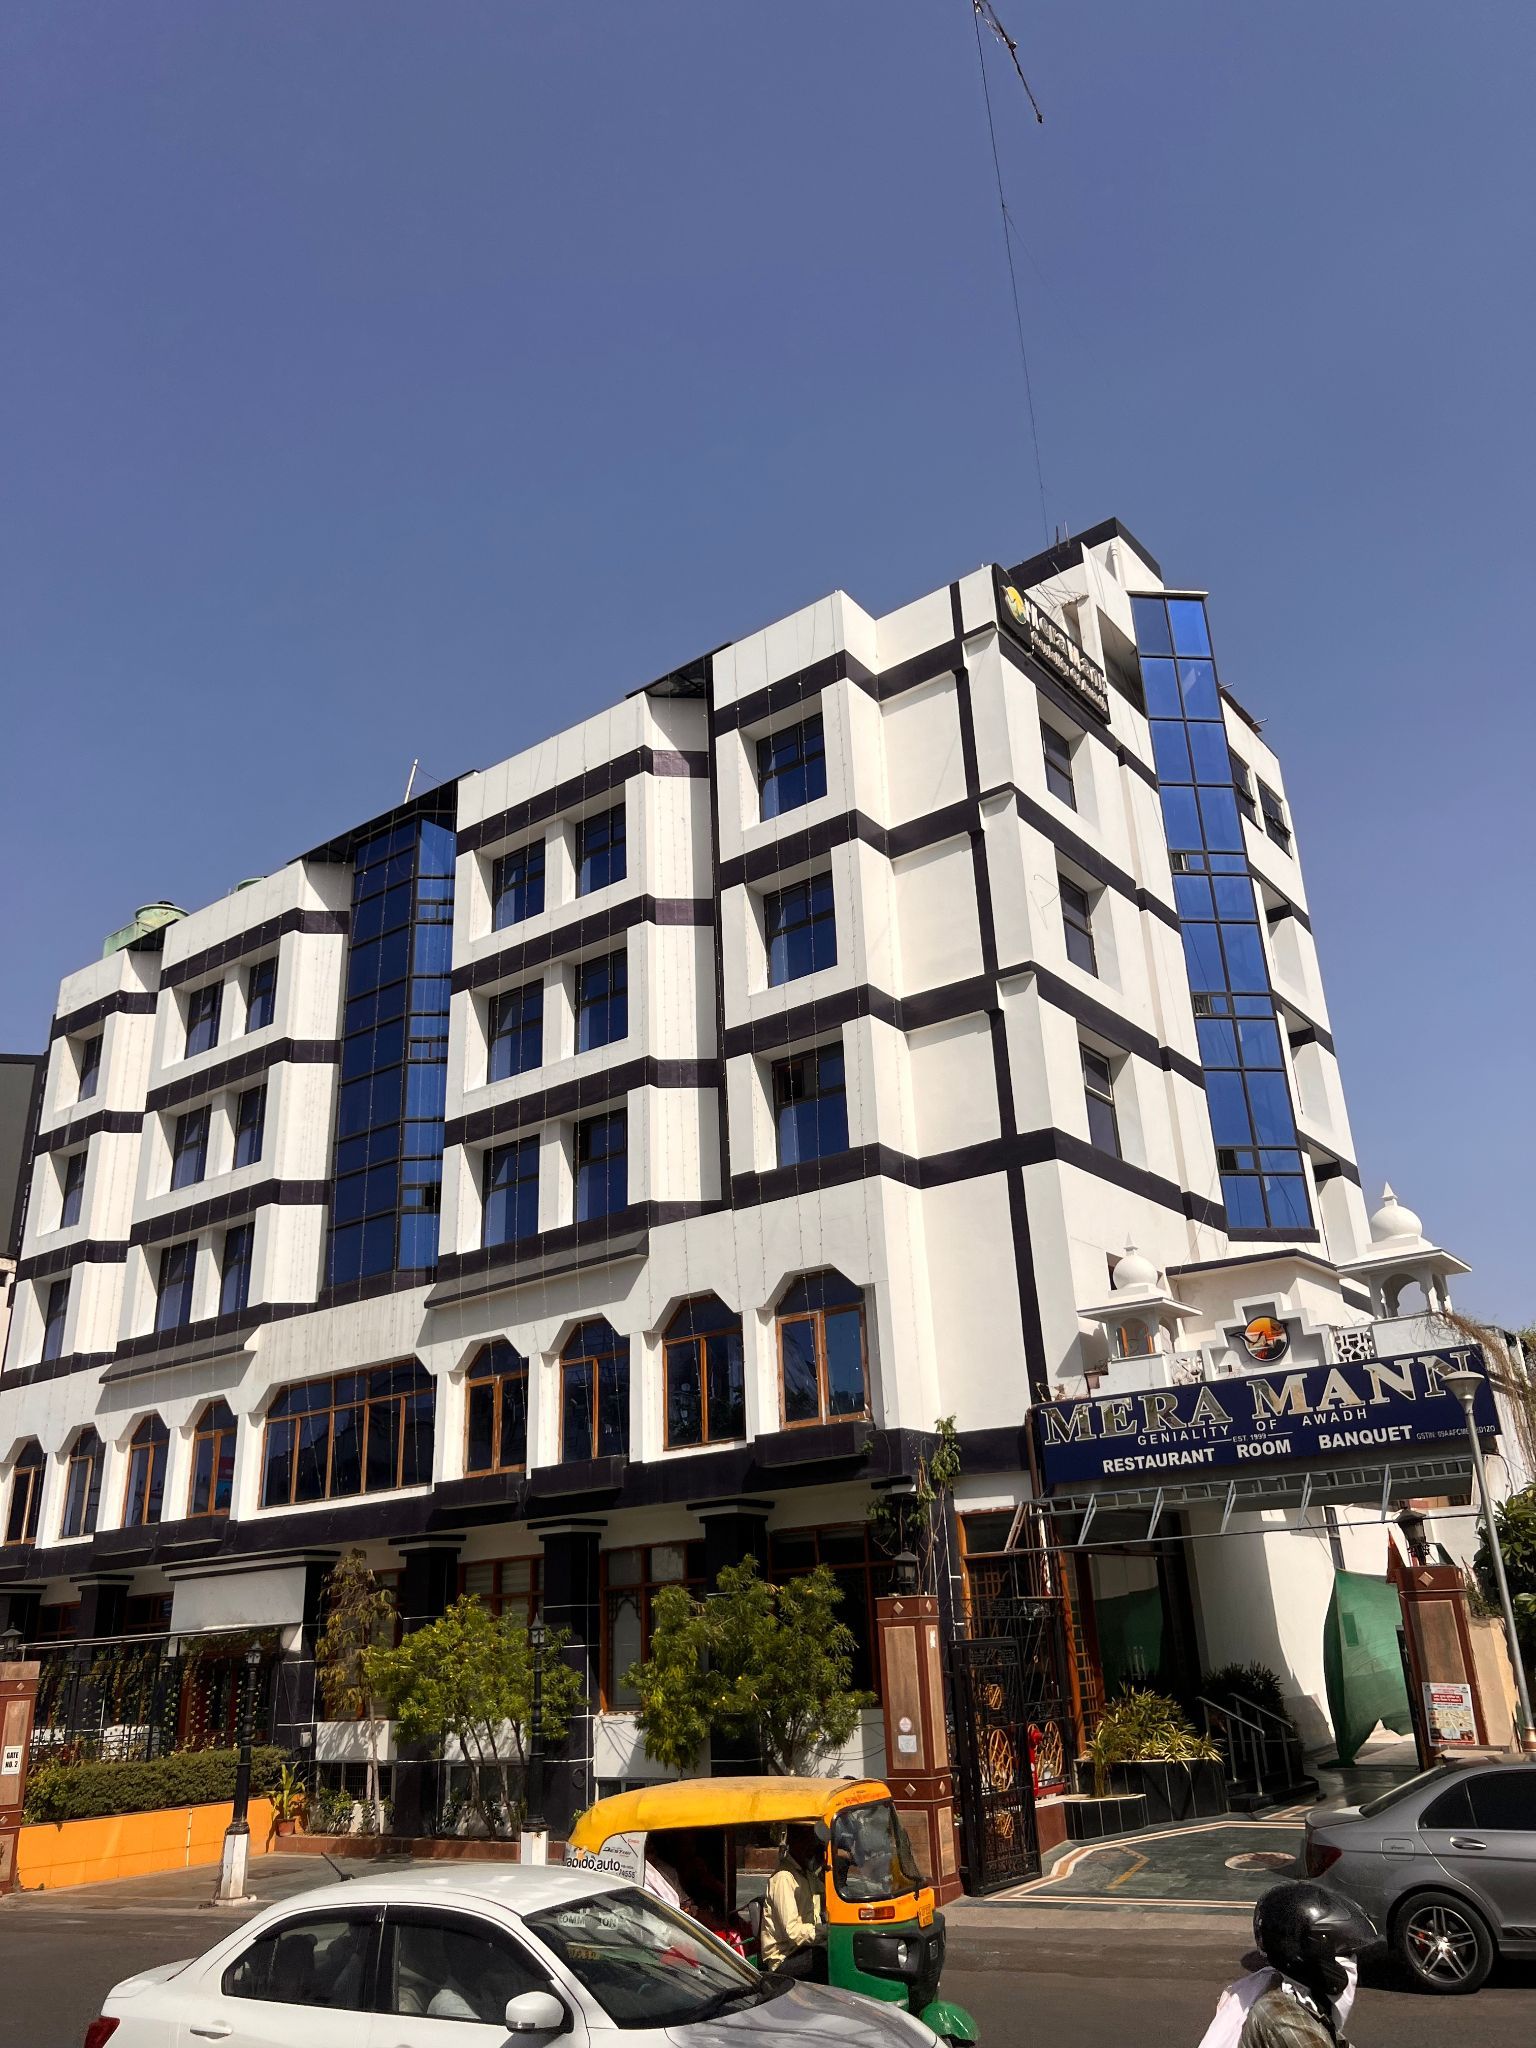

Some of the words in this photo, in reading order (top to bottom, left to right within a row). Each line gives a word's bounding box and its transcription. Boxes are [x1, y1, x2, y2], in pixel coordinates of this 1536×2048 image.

[1041, 1386, 1233, 1445] MERA
[1247, 1351, 1471, 1419] MANN
[1137, 1425, 1229, 1446] GENIALITY
[1256, 1419, 1277, 1432] OF
[1302, 1408, 1368, 1427] AWADH
[1103, 1447, 1215, 1473] RESTAURANT
[1237, 1438, 1292, 1459] ROOM
[1318, 1425, 1413, 1449] BANQUET
[6, 1751, 19, 1759] GATE
[14, 1760, 18, 1768] 2
[596, 1858, 620, 1872] auto
